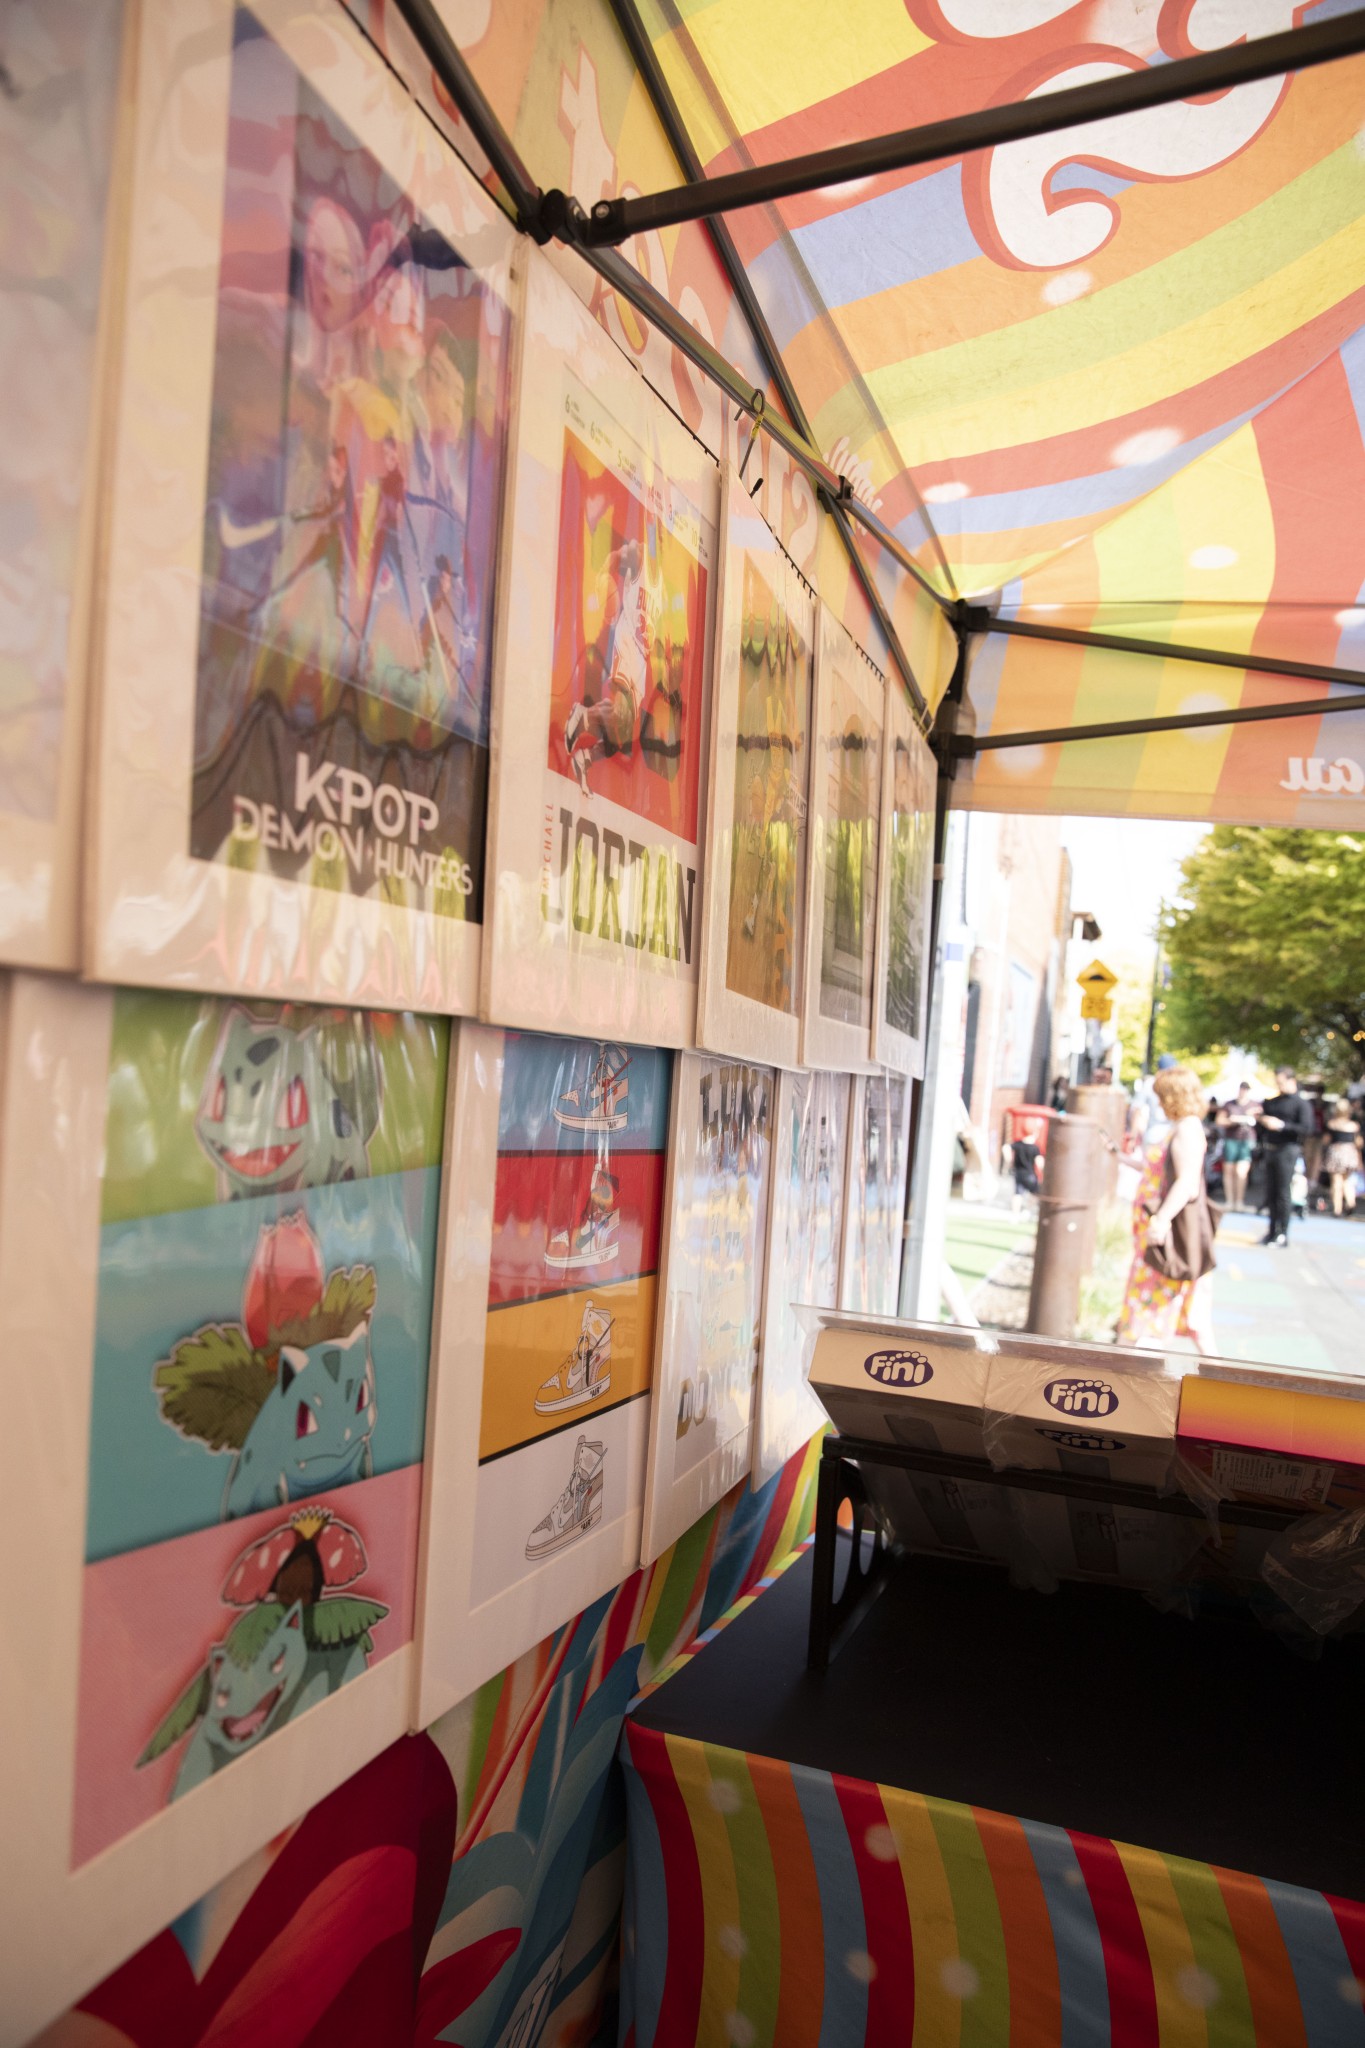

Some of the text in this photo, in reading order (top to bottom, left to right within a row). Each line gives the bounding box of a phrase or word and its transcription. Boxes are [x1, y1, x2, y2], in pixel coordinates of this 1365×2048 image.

[232, 795, 474, 896] DEMON HUNTERS
[541, 806, 696, 965] JORDAN
[542, 803, 554, 889] MICHAEL
[870, 1351, 927, 1385] Fini
[1050, 1380, 1113, 1415] Fini
